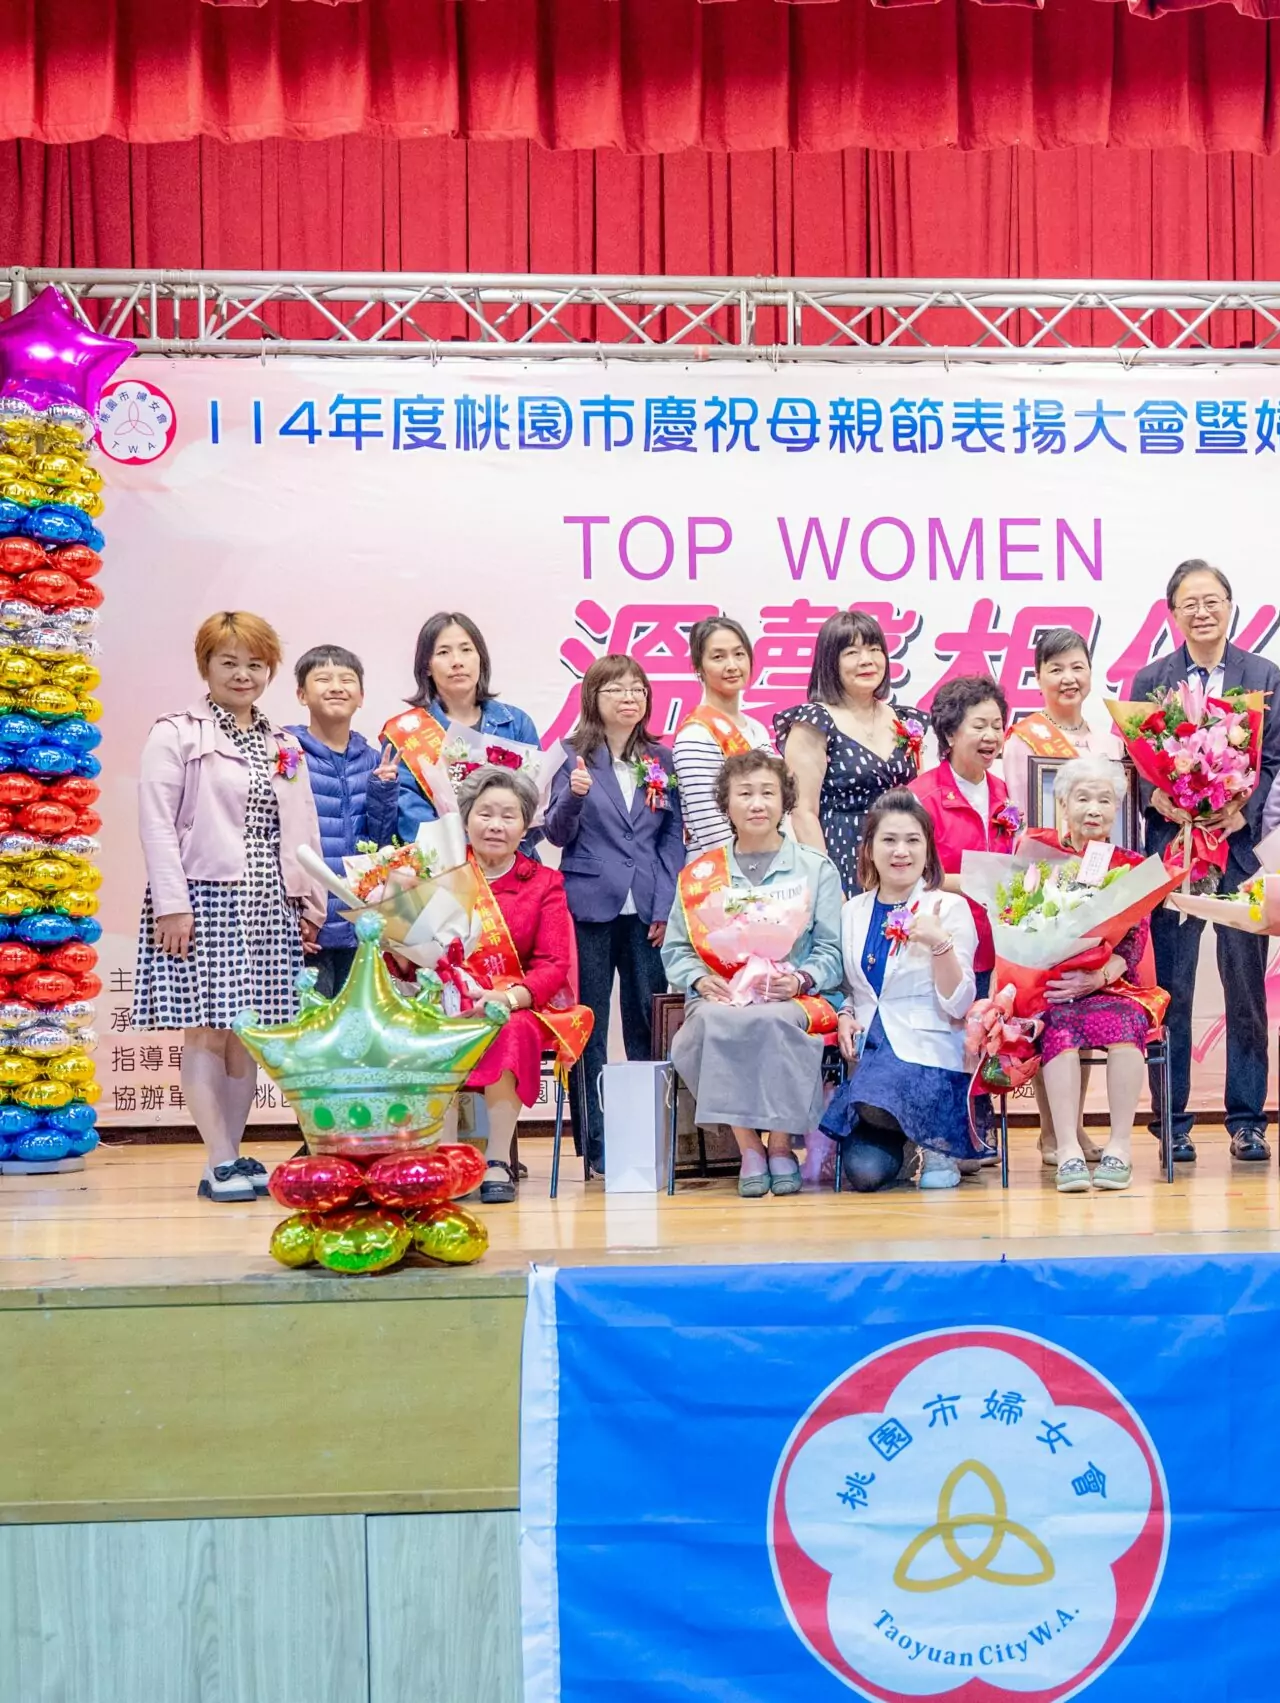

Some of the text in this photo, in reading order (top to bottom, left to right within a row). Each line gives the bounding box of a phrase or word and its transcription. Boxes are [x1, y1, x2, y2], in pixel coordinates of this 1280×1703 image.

[564, 516, 1103, 581] TOP WOMEN
[836, 1388, 1107, 1510] 桃園市婦女會
[874, 1608, 1080, 1667] Taoyuan City W.A.
